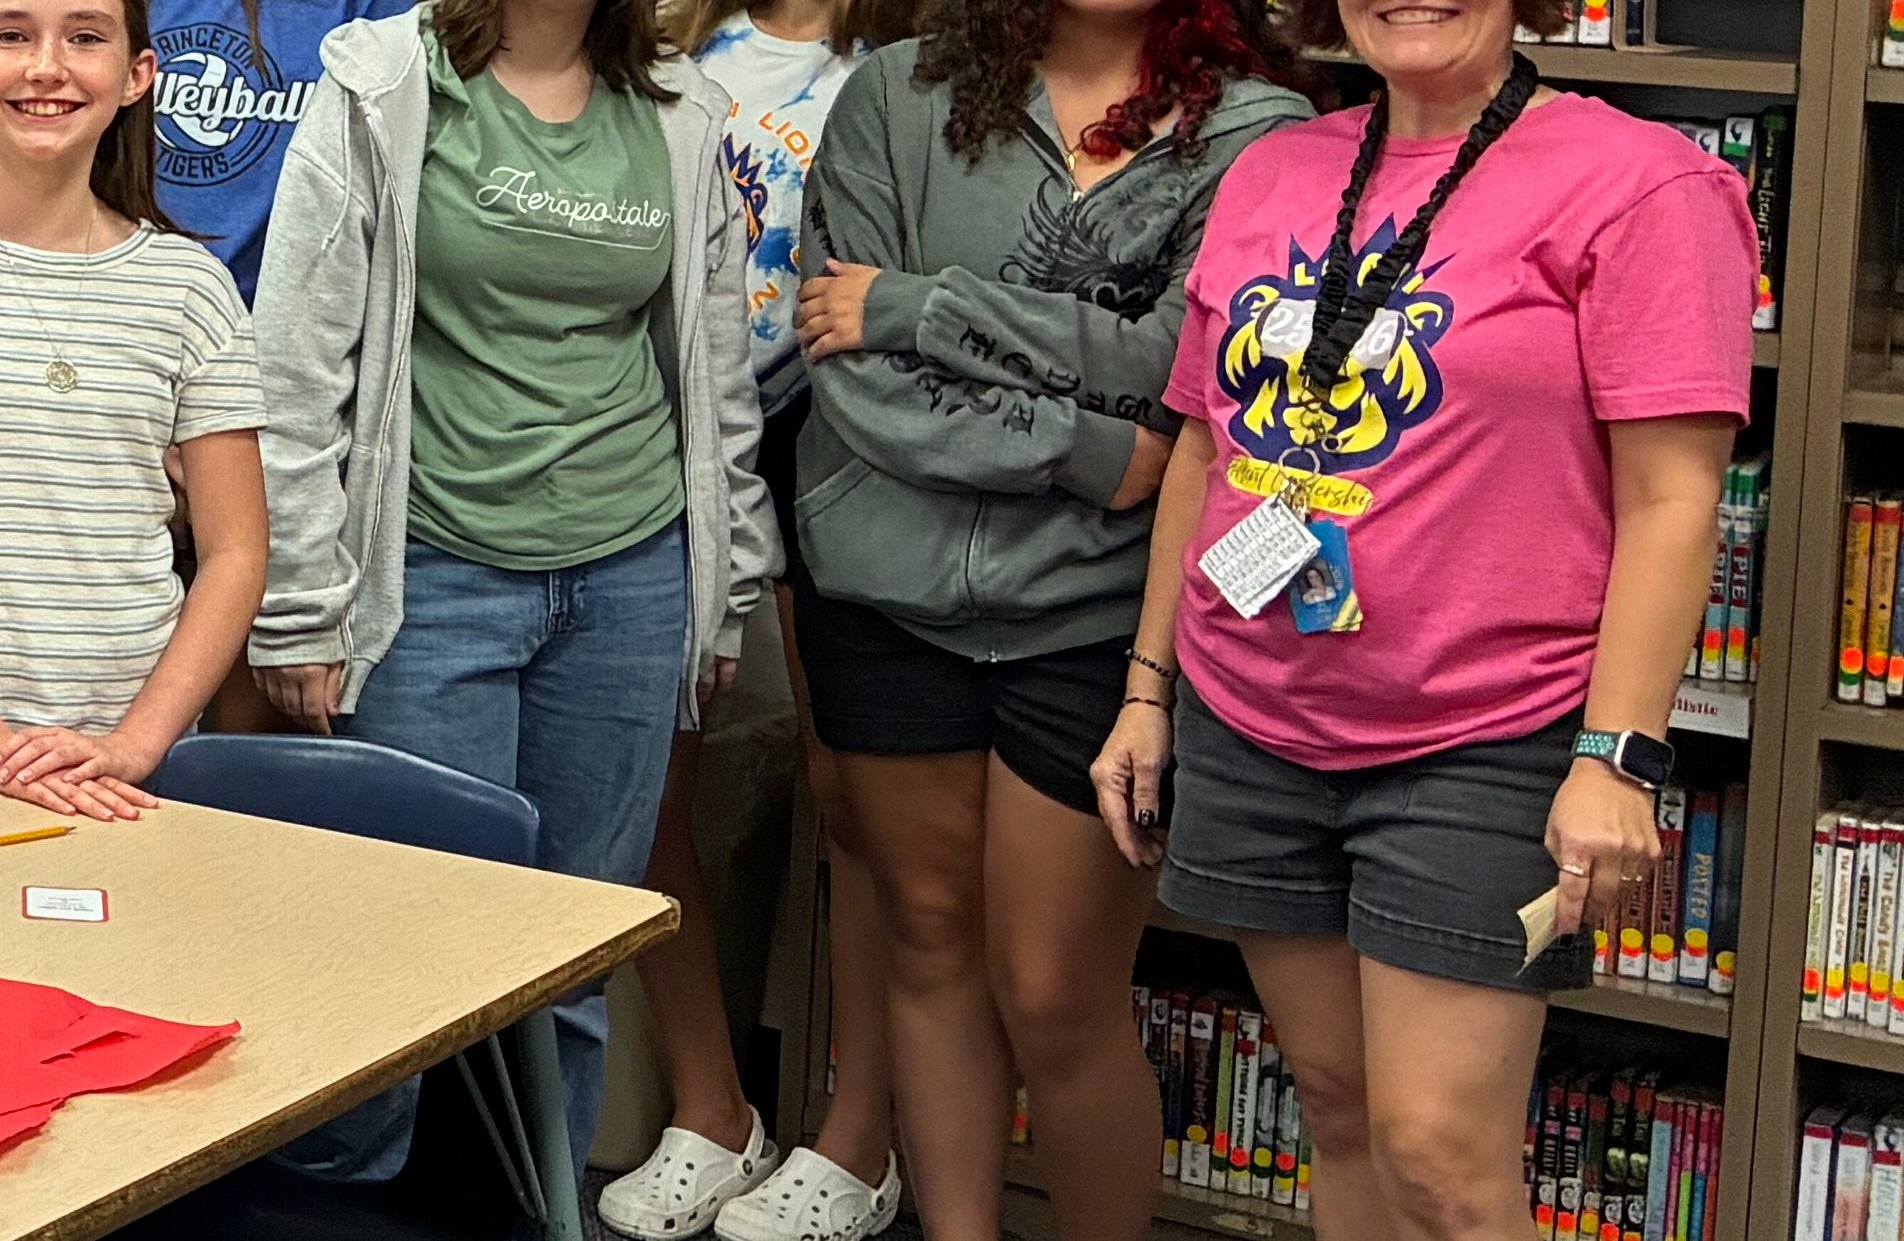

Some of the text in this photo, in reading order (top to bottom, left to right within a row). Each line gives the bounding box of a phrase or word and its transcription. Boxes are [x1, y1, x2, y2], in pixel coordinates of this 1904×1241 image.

[157, 148, 229, 179] TIGERS
[759, 111, 812, 166] LIO
[476, 166, 671, 228] Aeropostale
[1690, 851, 1714, 919] POSTED
